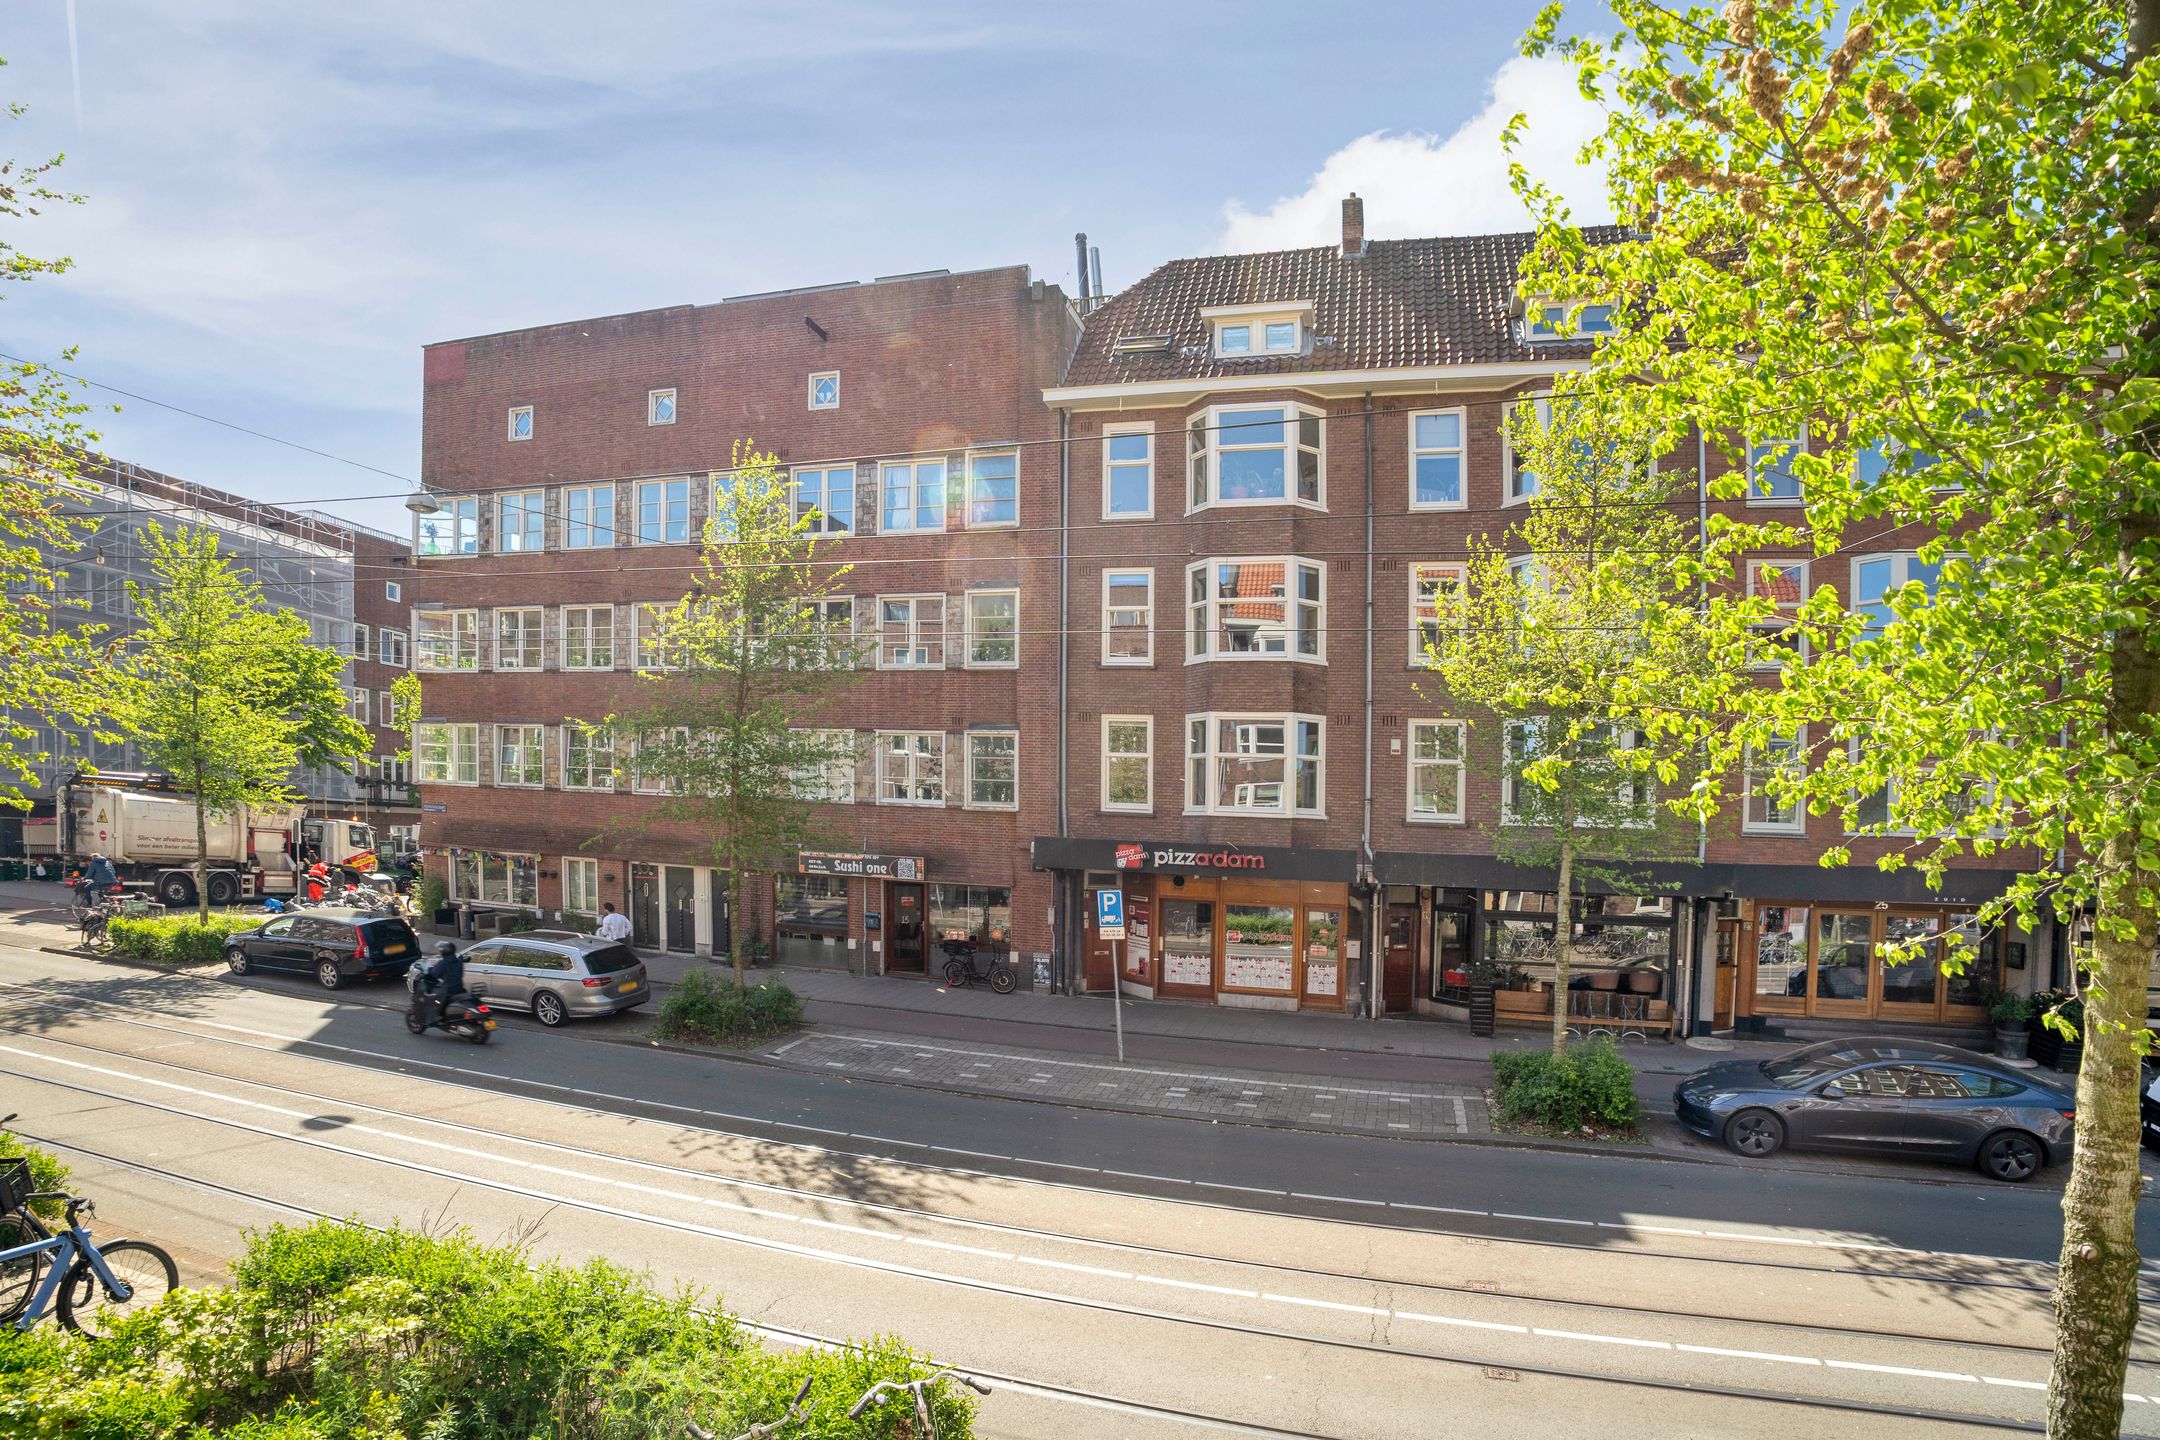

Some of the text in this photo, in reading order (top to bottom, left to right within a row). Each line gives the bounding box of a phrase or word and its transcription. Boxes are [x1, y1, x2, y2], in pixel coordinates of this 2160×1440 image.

[1128, 853, 1147, 861] dam
[834, 859, 863, 873] Sushi
[866, 864, 887, 874] one
[1103, 893, 1117, 912] P
[1874, 901, 1889, 910] 25
[901, 915, 910, 924] 15
